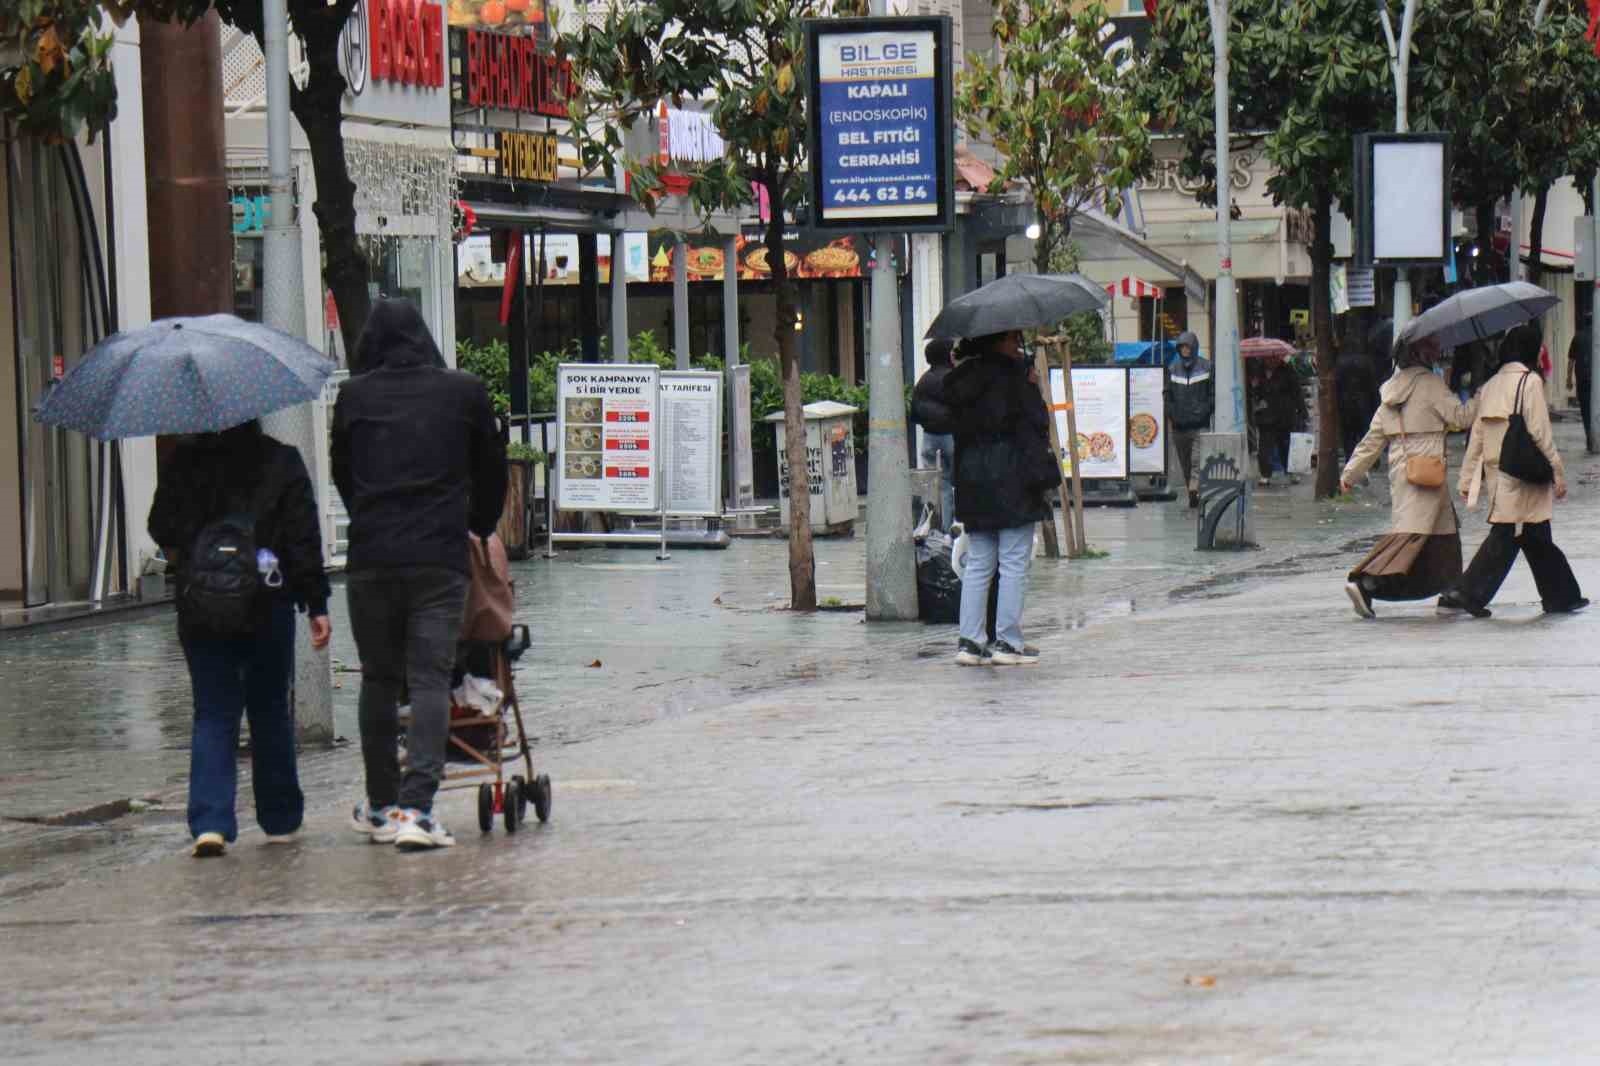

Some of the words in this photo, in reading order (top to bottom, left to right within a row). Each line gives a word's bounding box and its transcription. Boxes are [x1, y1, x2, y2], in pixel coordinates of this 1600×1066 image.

[368, 0, 445, 88] BOSCH
[848, 83, 907, 99] KAPALI
[829, 105, 928, 125] (ENDOSKOPİK)
[838, 132, 870, 145] BEL
[873, 126, 920, 144] FITIĞI
[839, 149, 920, 168] CERRAHİSİ
[834, 187, 871, 202] 444
[876, 186, 899, 201] 62
[904, 185, 928, 200] 54
[608, 386, 641, 394] YERDE
